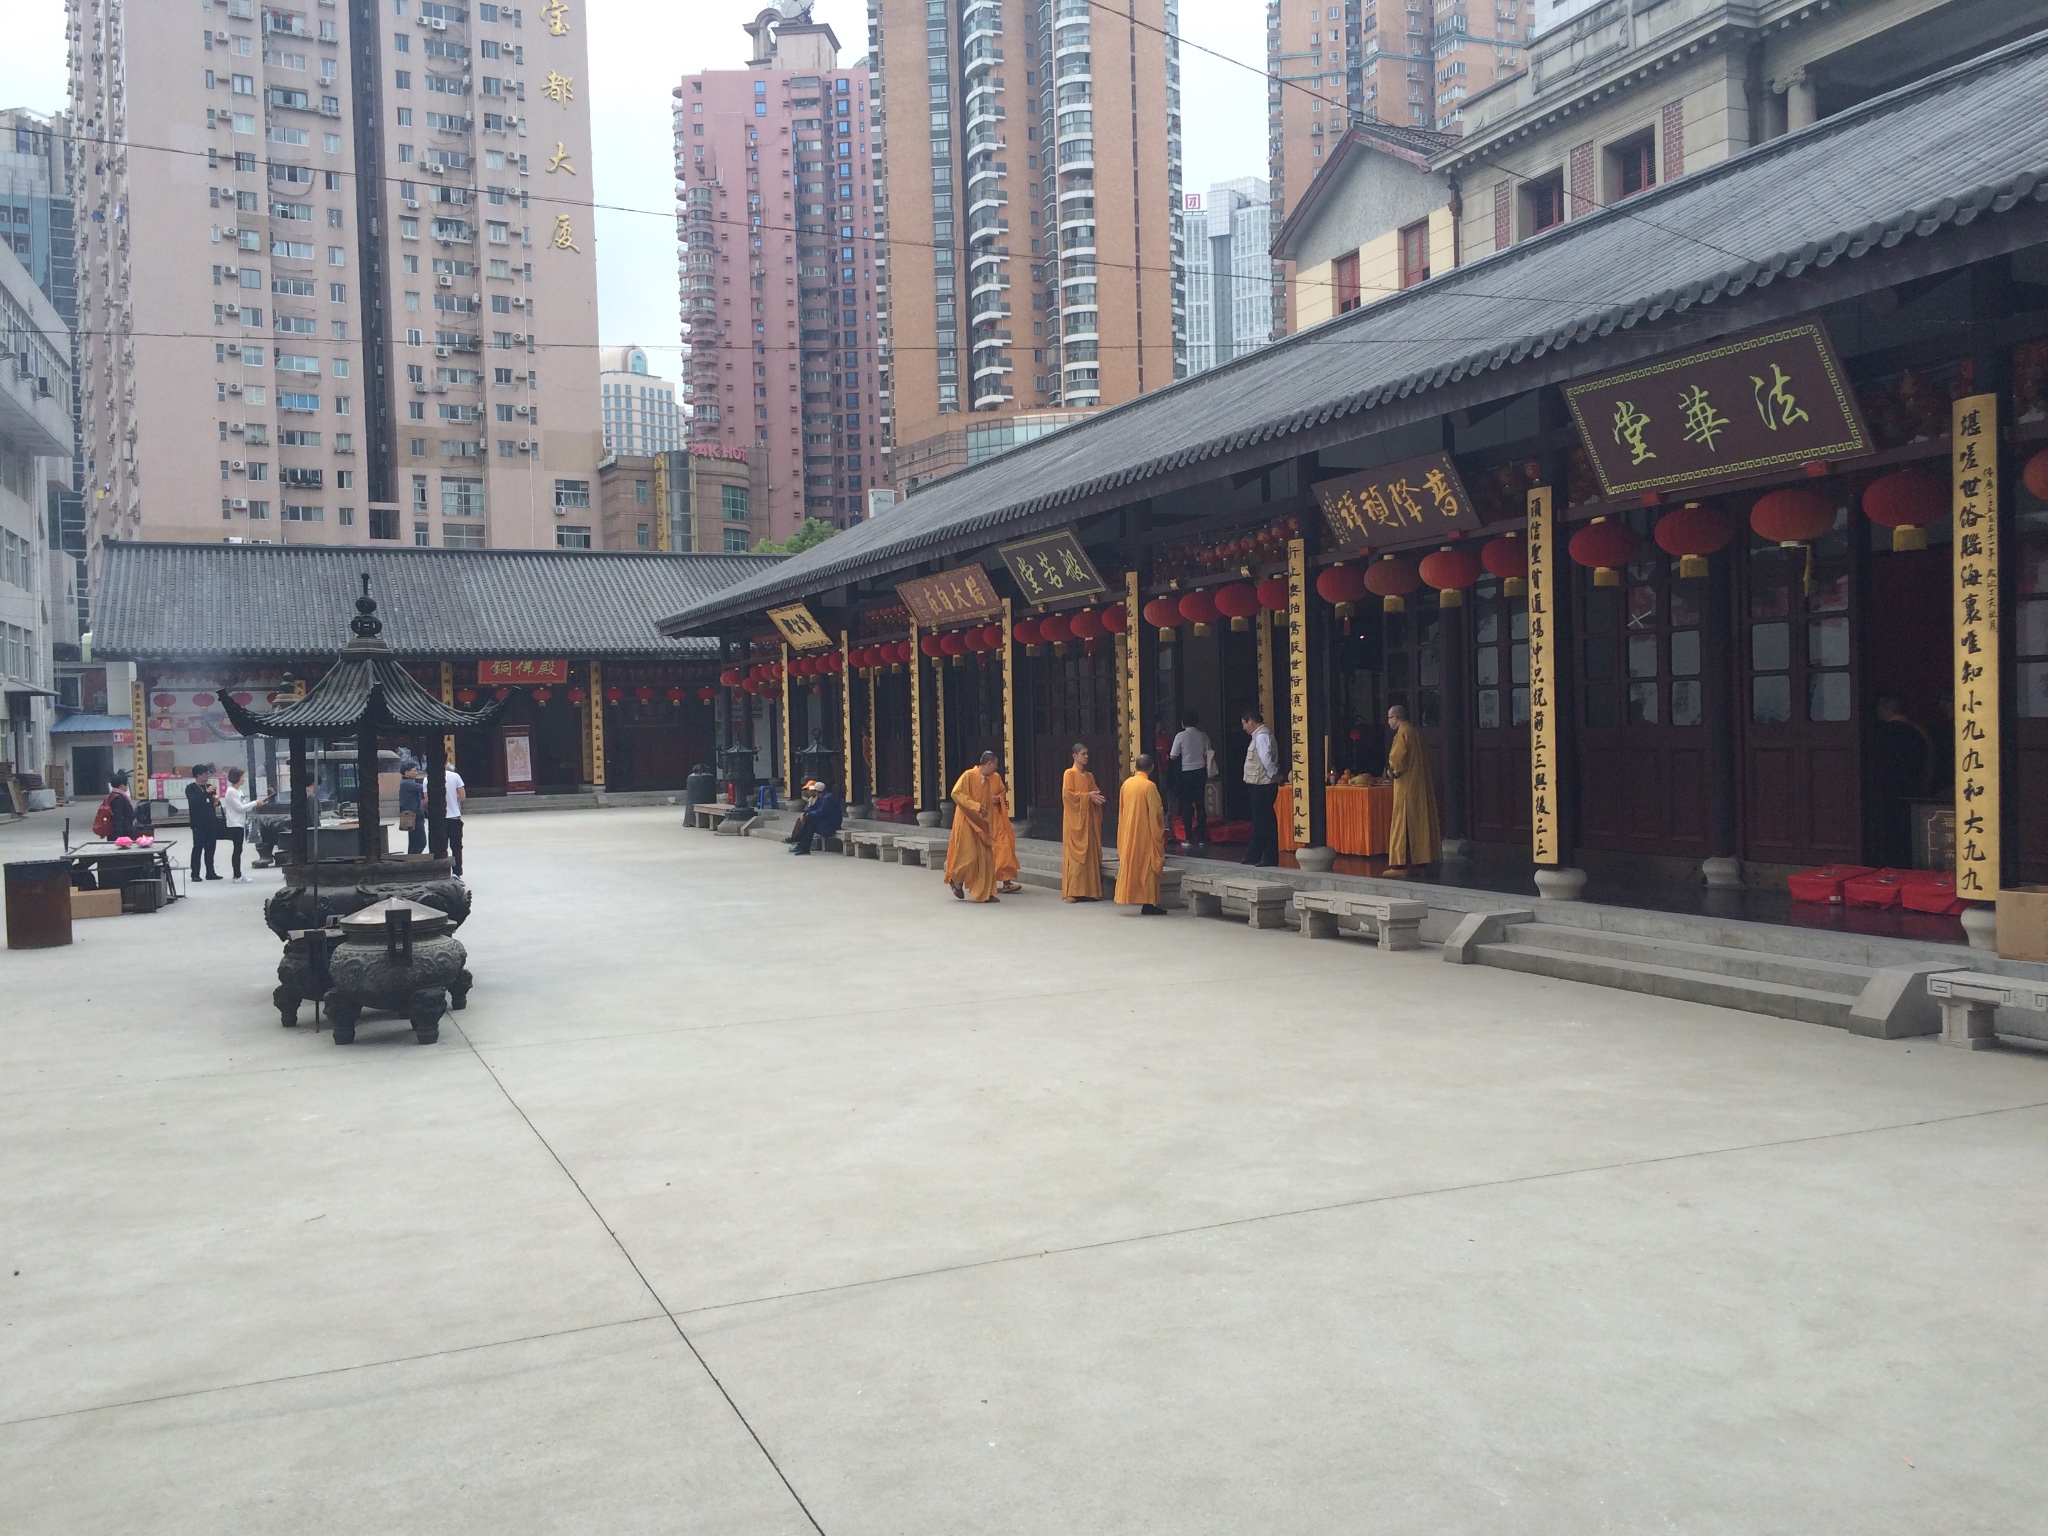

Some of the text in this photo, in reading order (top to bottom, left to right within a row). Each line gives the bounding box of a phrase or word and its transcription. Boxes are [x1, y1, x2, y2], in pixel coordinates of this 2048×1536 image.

[540, 0, 580, 253] 宝都大厦
[1611, 362, 1810, 466] 法華堂
[490, 660, 558, 677] 銅佛殿
